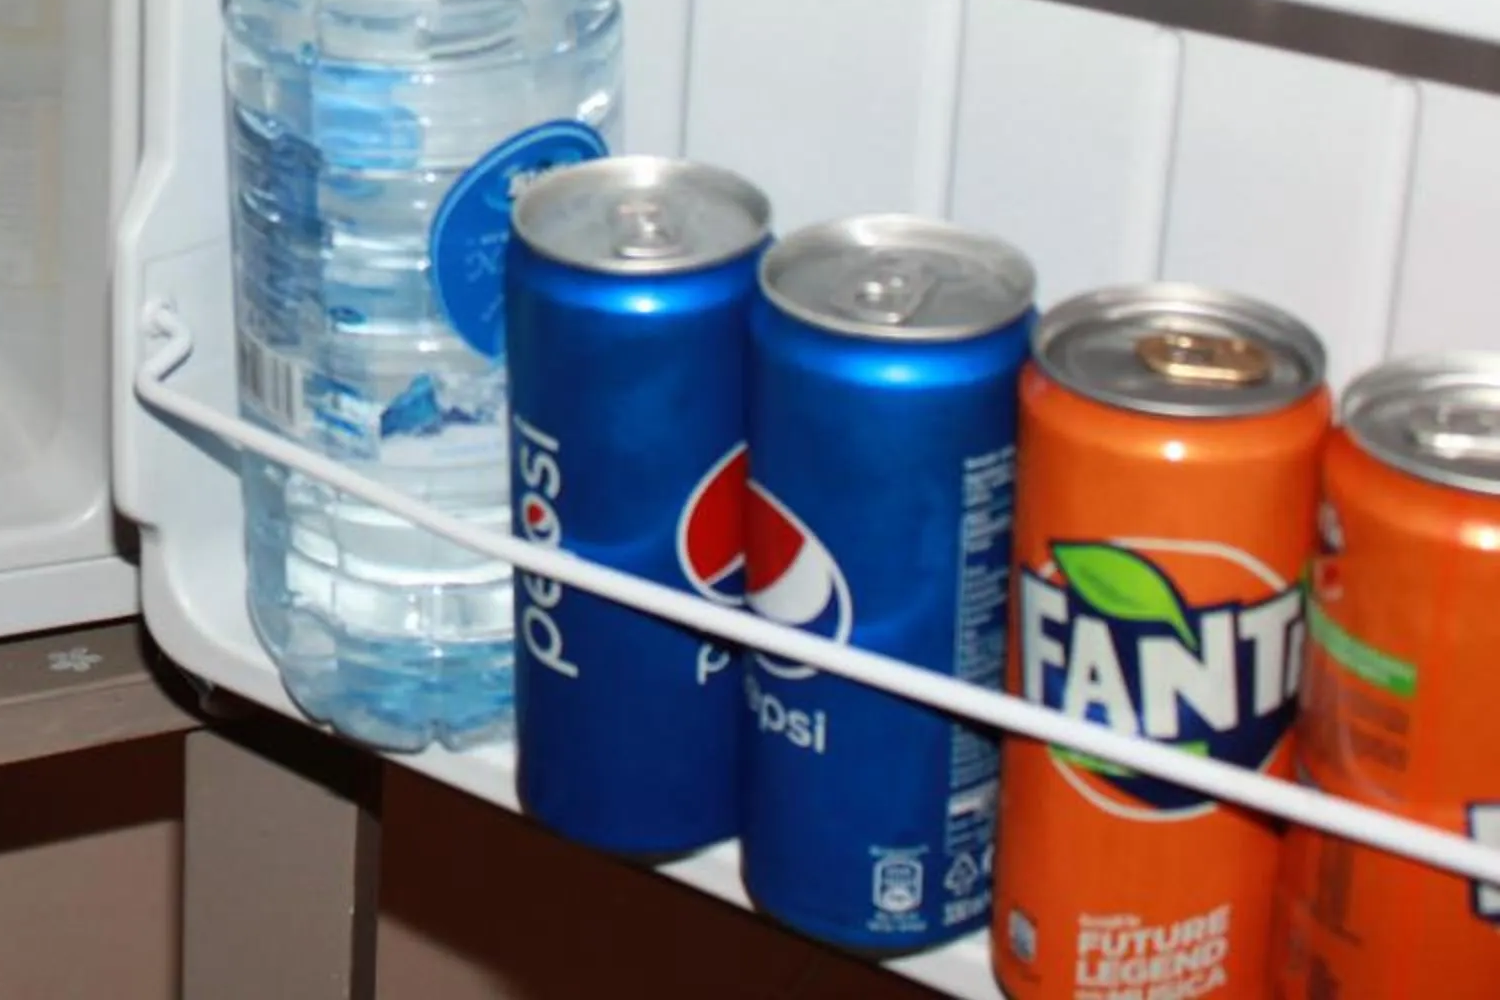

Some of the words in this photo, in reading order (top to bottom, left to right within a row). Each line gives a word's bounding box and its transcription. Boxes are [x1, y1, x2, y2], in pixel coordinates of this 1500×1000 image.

[750, 682, 826, 755] psi
[1077, 902, 1232, 957] FUTURE
[1075, 937, 1229, 986] LEGEND
